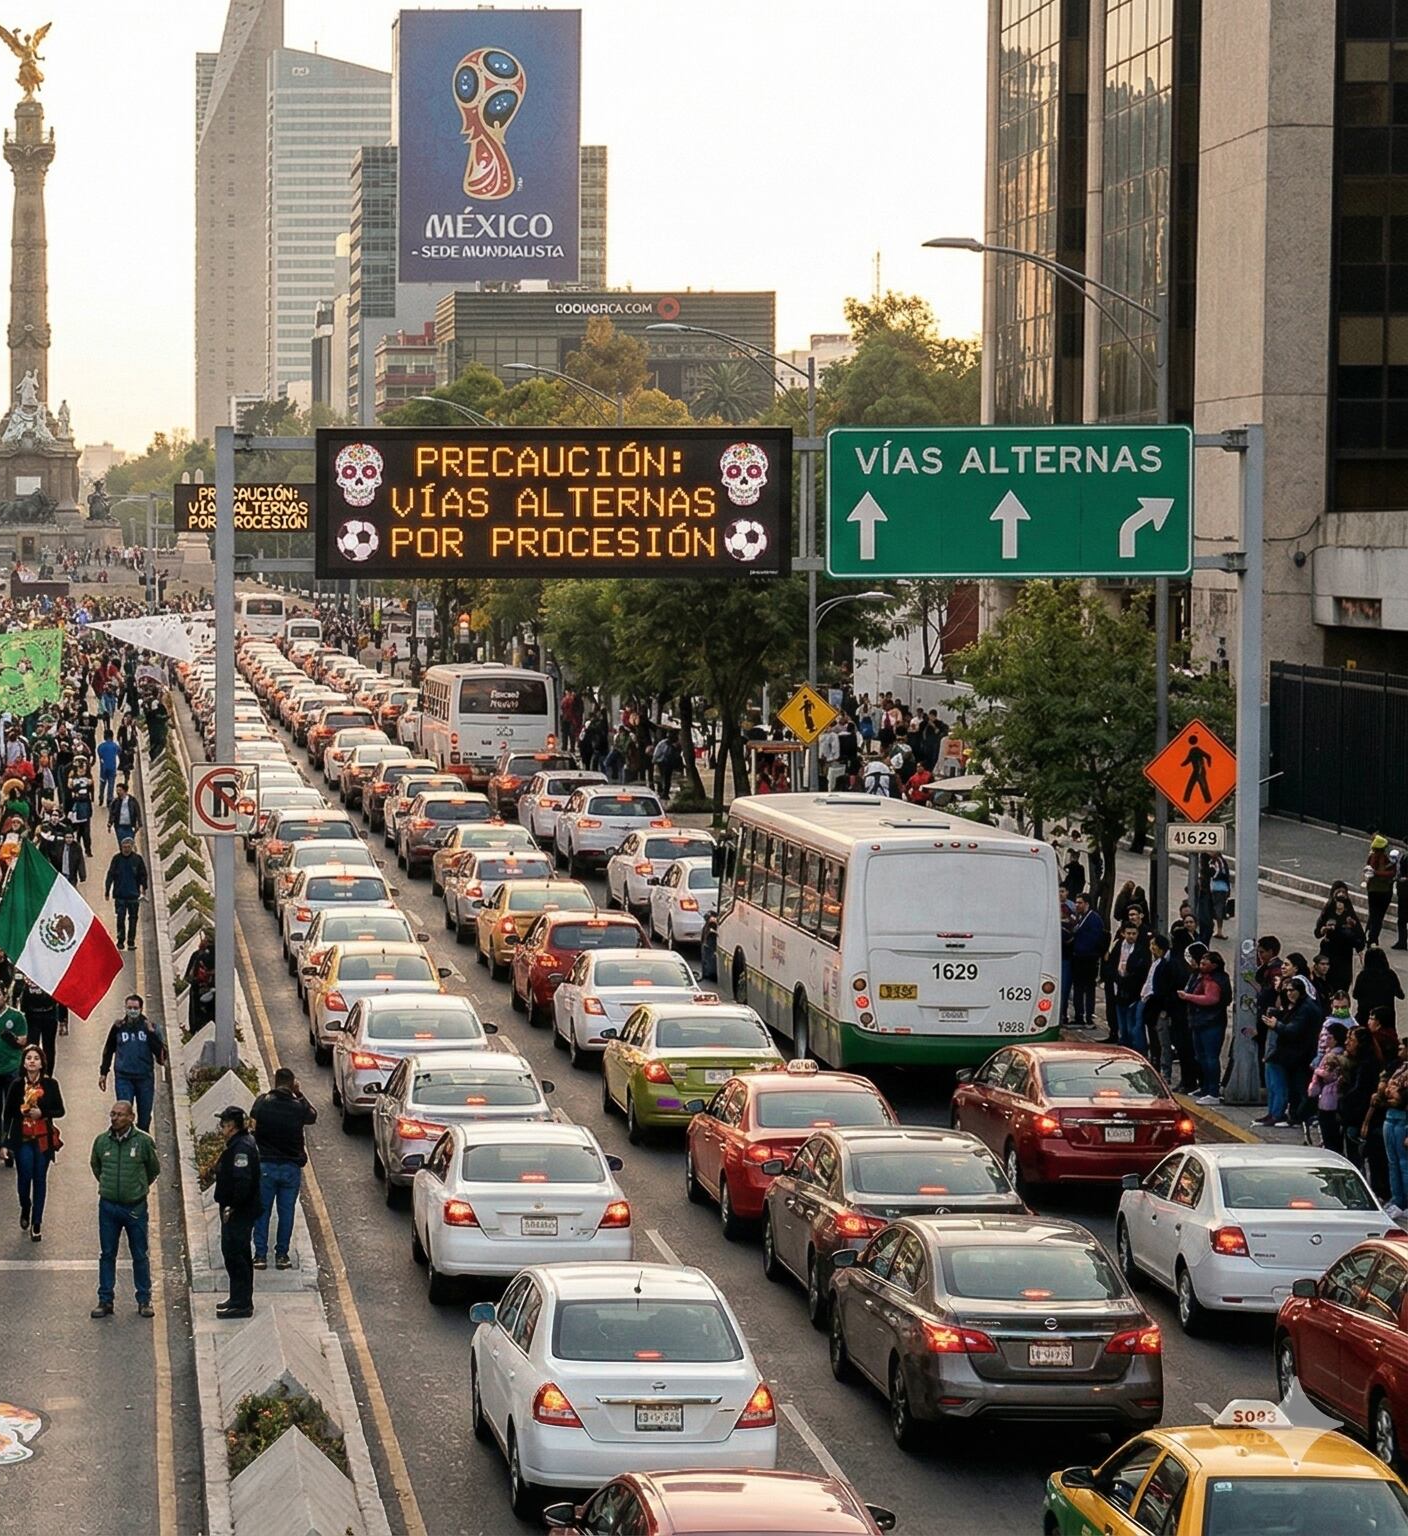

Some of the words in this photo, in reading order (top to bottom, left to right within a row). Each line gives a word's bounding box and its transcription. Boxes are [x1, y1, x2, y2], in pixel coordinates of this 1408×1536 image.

[425, 206, 553, 238] MÉXICO
[421, 245, 459, 258] SEDE
[462, 245, 565, 258] MUNDIALISTA
[416, 441, 682, 478] PRECAUCIÓN:
[854, 440, 943, 475] VÍAS
[959, 445, 1162, 475] ALTERNAS
[198, 484, 299, 501] PRAUCIÓN:
[391, 482, 489, 518] VÍAS
[517, 486, 716, 518] ALTERNAS
[188, 500, 217, 514] VÍA
[188, 515, 217, 529] POR
[233, 513, 308, 529] ROCESIÓN
[391, 526, 464, 558] POR
[492, 522, 715, 558] PROCESIÓN
[932, 963, 978, 980] 1629
[998, 986, 1032, 1001] 1629
